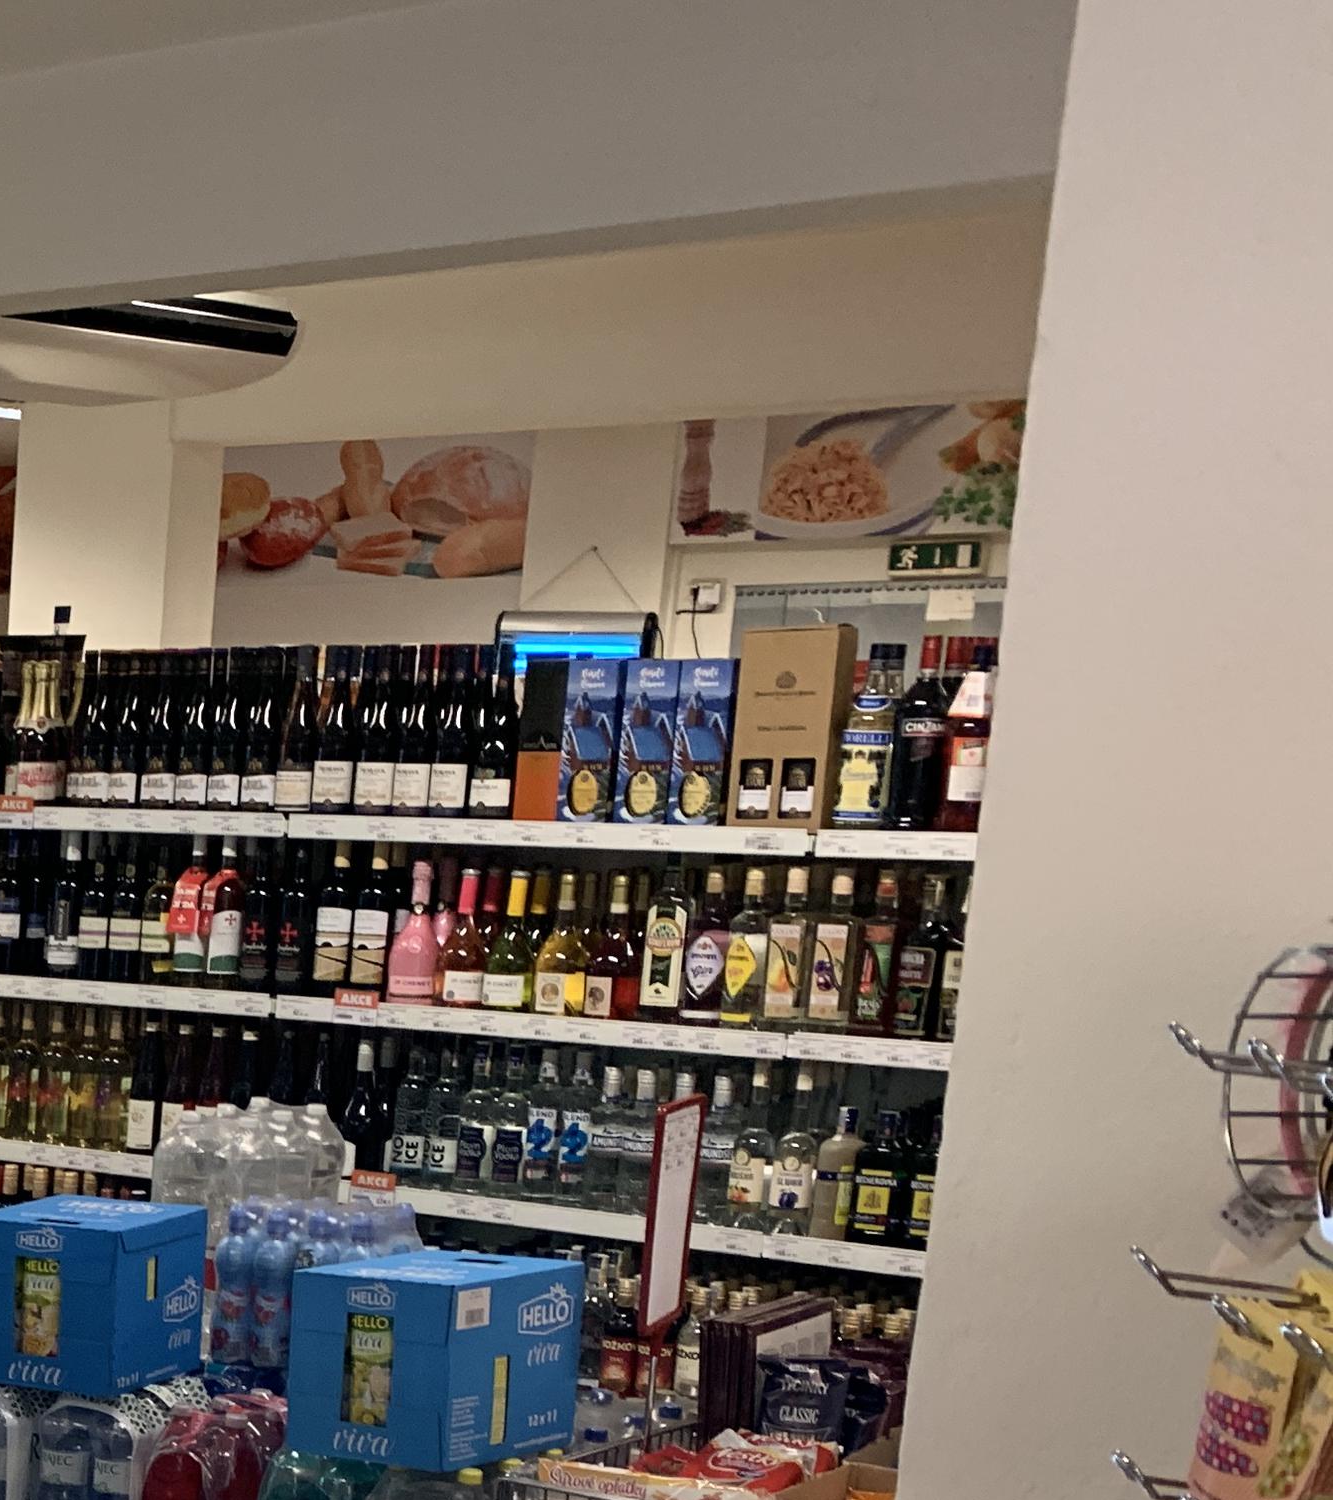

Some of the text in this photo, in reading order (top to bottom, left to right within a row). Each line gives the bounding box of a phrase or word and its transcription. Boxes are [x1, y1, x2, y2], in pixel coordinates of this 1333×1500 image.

[905, 719, 944, 734] CINZAN
[18, 1235, 59, 1249] HELLO
[165, 1289, 199, 1317] HELLO
[351, 1292, 391, 1307] HELLO
[521, 1300, 570, 1328] HELLO
[8, 1360, 63, 1386] viva
[779, 1405, 821, 1424] CLASSIC
[333, 1427, 391, 1457] viva
[598, 1476, 647, 1498] oplatky
